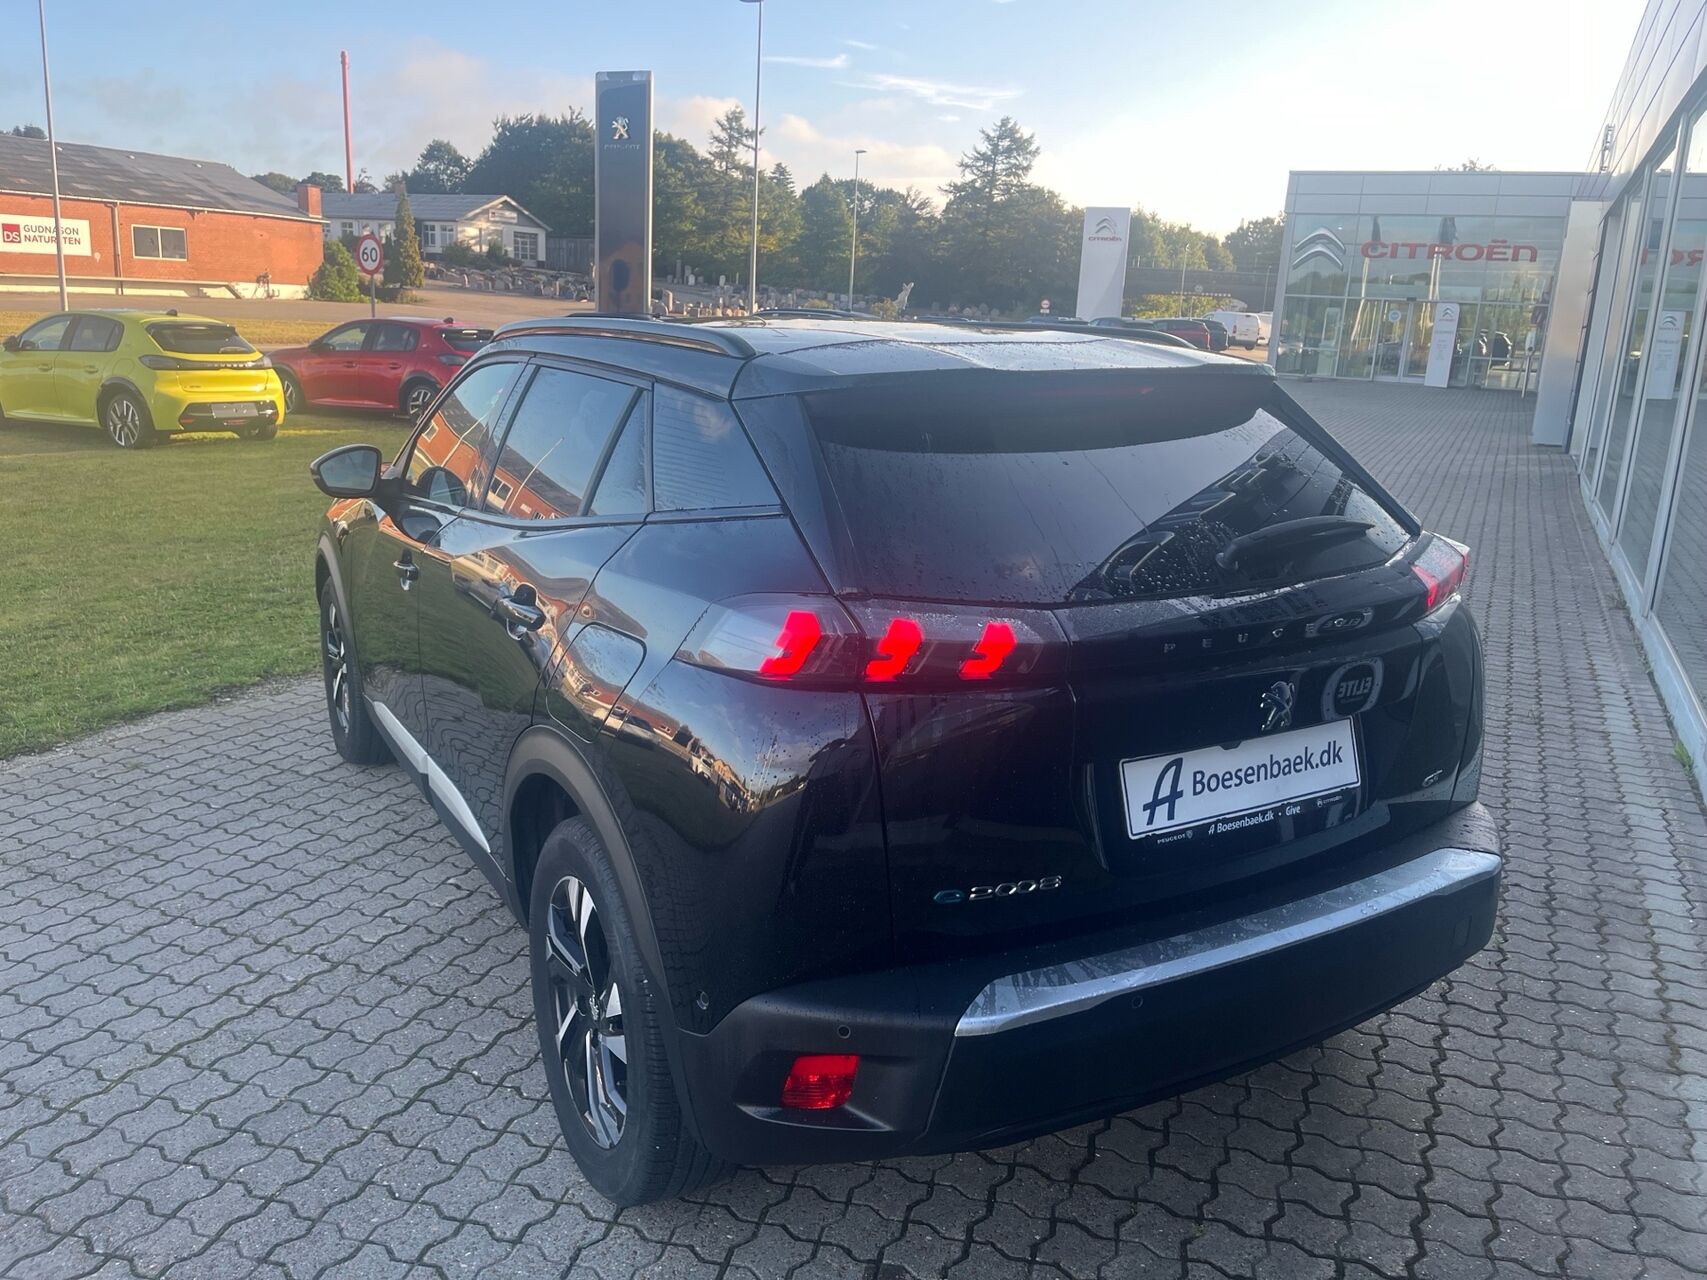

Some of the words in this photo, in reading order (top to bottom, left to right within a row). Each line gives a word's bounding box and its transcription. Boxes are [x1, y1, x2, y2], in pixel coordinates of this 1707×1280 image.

[3, 231, 20, 242] DS
[24, 234, 81, 245] NATURTEN
[361, 247, 378, 262] 60
[1361, 239, 1538, 262] CITROËN
[1142, 757, 1184, 826] A
[1192, 740, 1343, 797] Boesenbaek.dk
[1217, 810, 1275, 833] Boesenbaek.dk
[1285, 805, 1301, 816] Give
